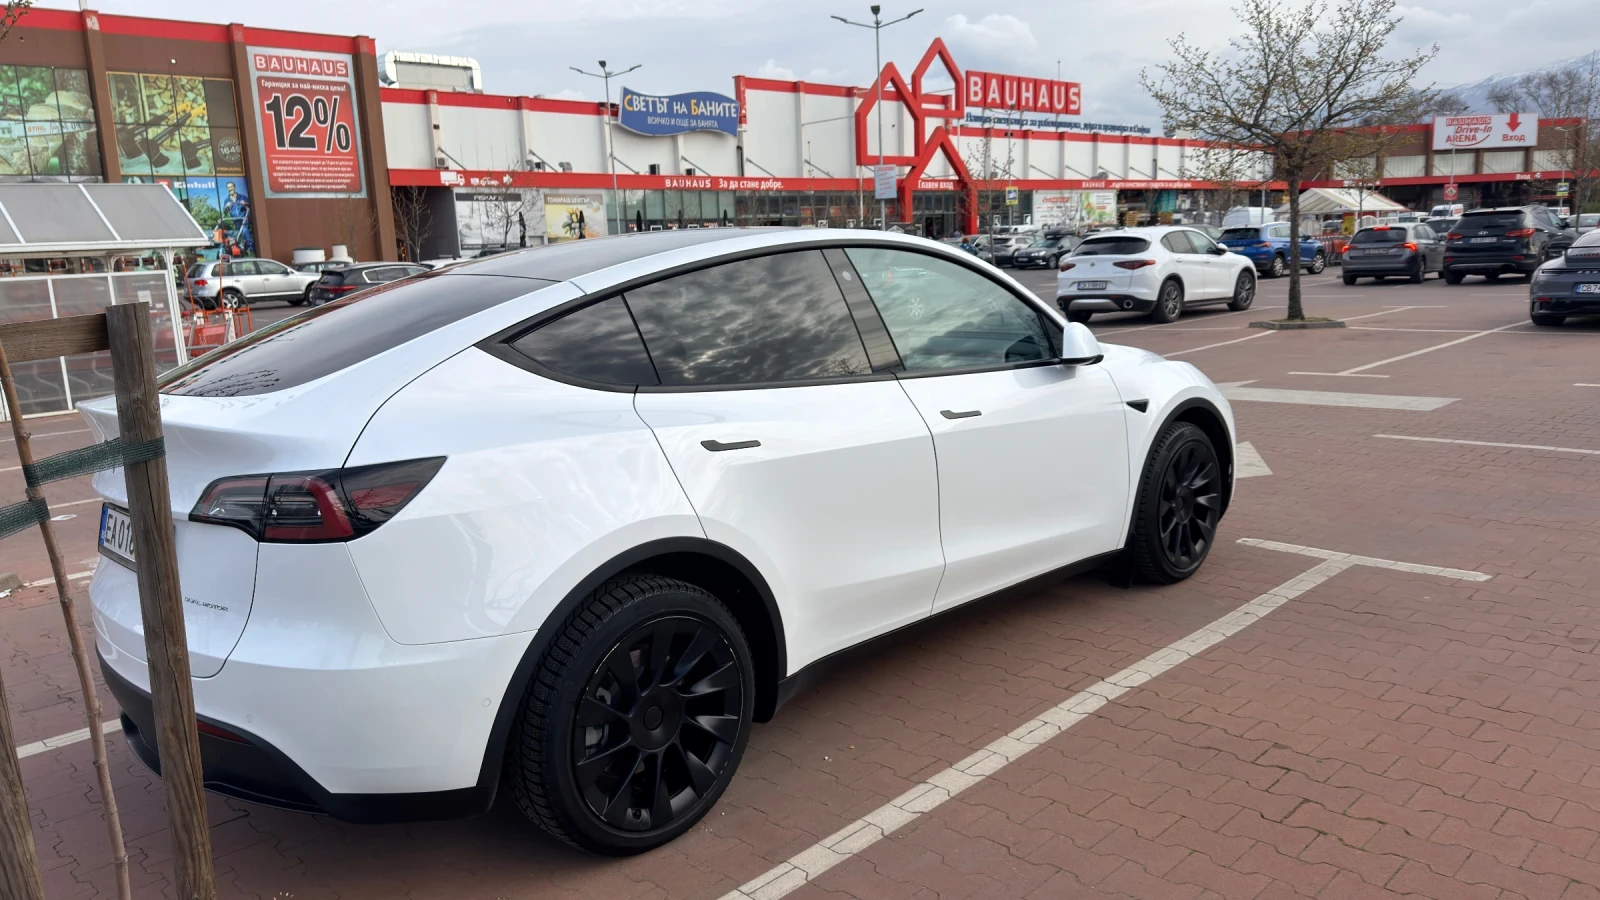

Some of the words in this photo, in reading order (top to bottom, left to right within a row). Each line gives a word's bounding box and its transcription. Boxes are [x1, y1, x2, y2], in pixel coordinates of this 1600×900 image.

[255, 56, 347, 74] BAUHAUS
[261, 79, 291, 89] Гаранция
[299, 82, 329, 91] най-ниска
[969, 76, 1080, 110] BAUHAUS
[624, 94, 669, 114] СВЕТЪТ
[673, 101, 688, 114] НА
[691, 99, 737, 117] БАНИТЕ
[264, 93, 351, 153] 12%
[647, 116, 670, 125] ВСИЧКО
[671, 117, 675, 125] И
[676, 119, 689, 127] ОЩЕ
[697, 120, 718, 128] БАНЯТА
[1446, 117, 1492, 126] BAUHAUS
[1455, 126, 1492, 134] Drive-In
[1446, 134, 1477, 142] ARENA
[1502, 134, 1525, 142] Вход
[174, 181, 216, 189] Einhell
[665, 179, 712, 188] BAUHAUS
[718, 179, 728, 187] За
[729, 181, 739, 189] да
[740, 180, 760, 188] стане
[761, 179, 784, 189] добре.
[918, 180, 939, 189] Главен
[940, 181, 954, 190] вход
